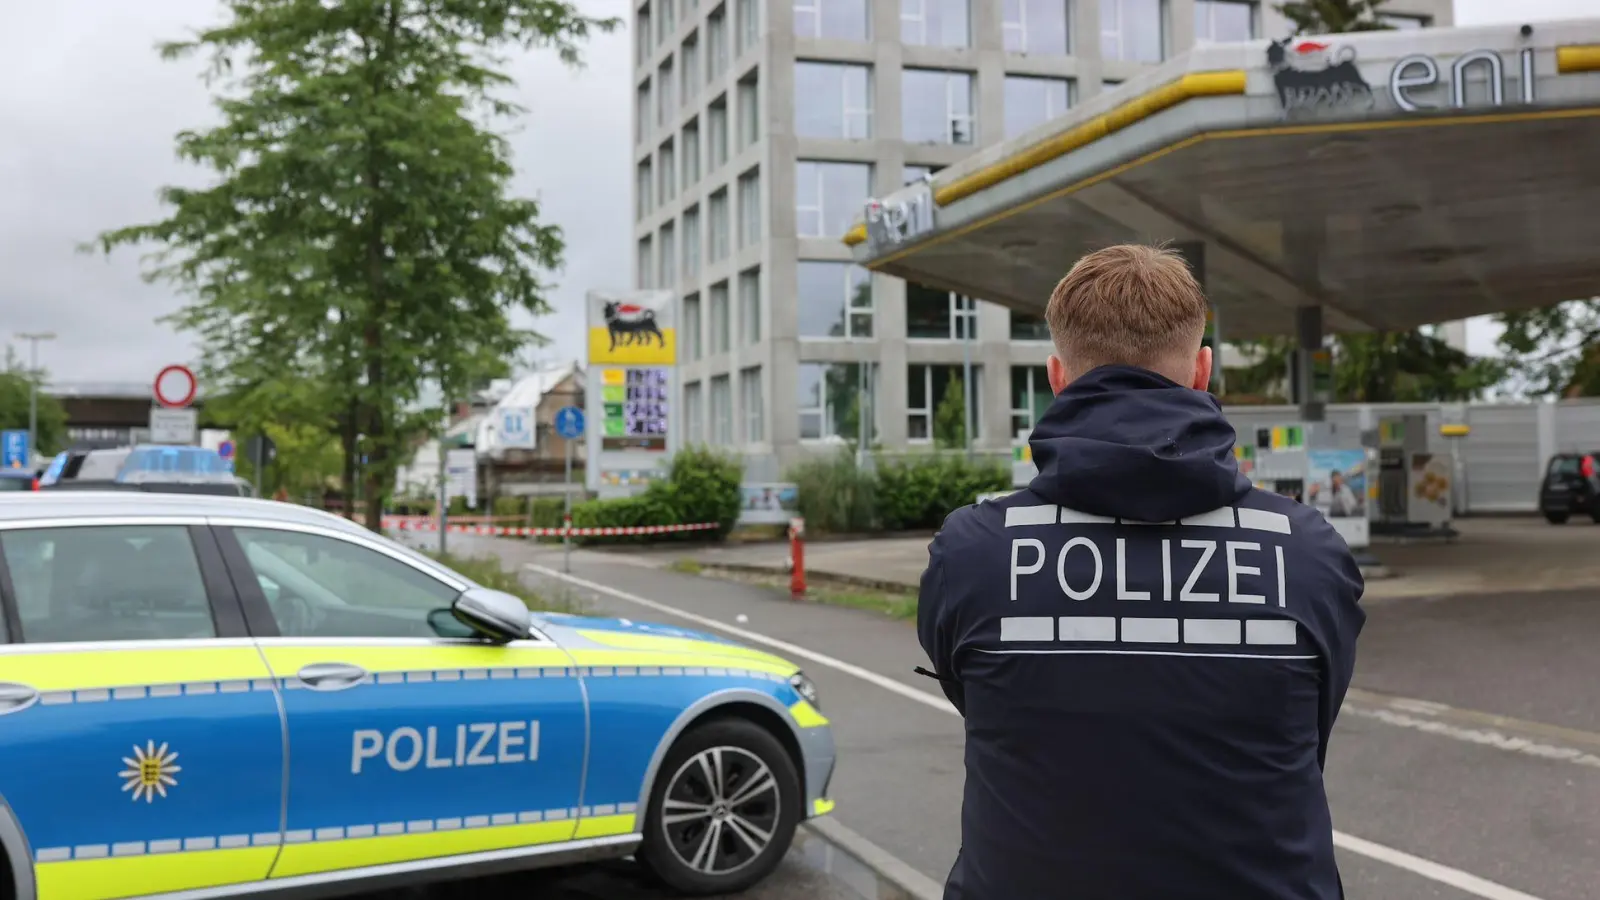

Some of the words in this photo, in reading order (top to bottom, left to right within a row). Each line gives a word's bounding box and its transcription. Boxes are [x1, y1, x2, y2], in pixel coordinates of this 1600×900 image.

[1390, 24, 1534, 111] eni
[1010, 537, 1286, 608] POLIZEI
[351, 720, 540, 774] POLIZEI
